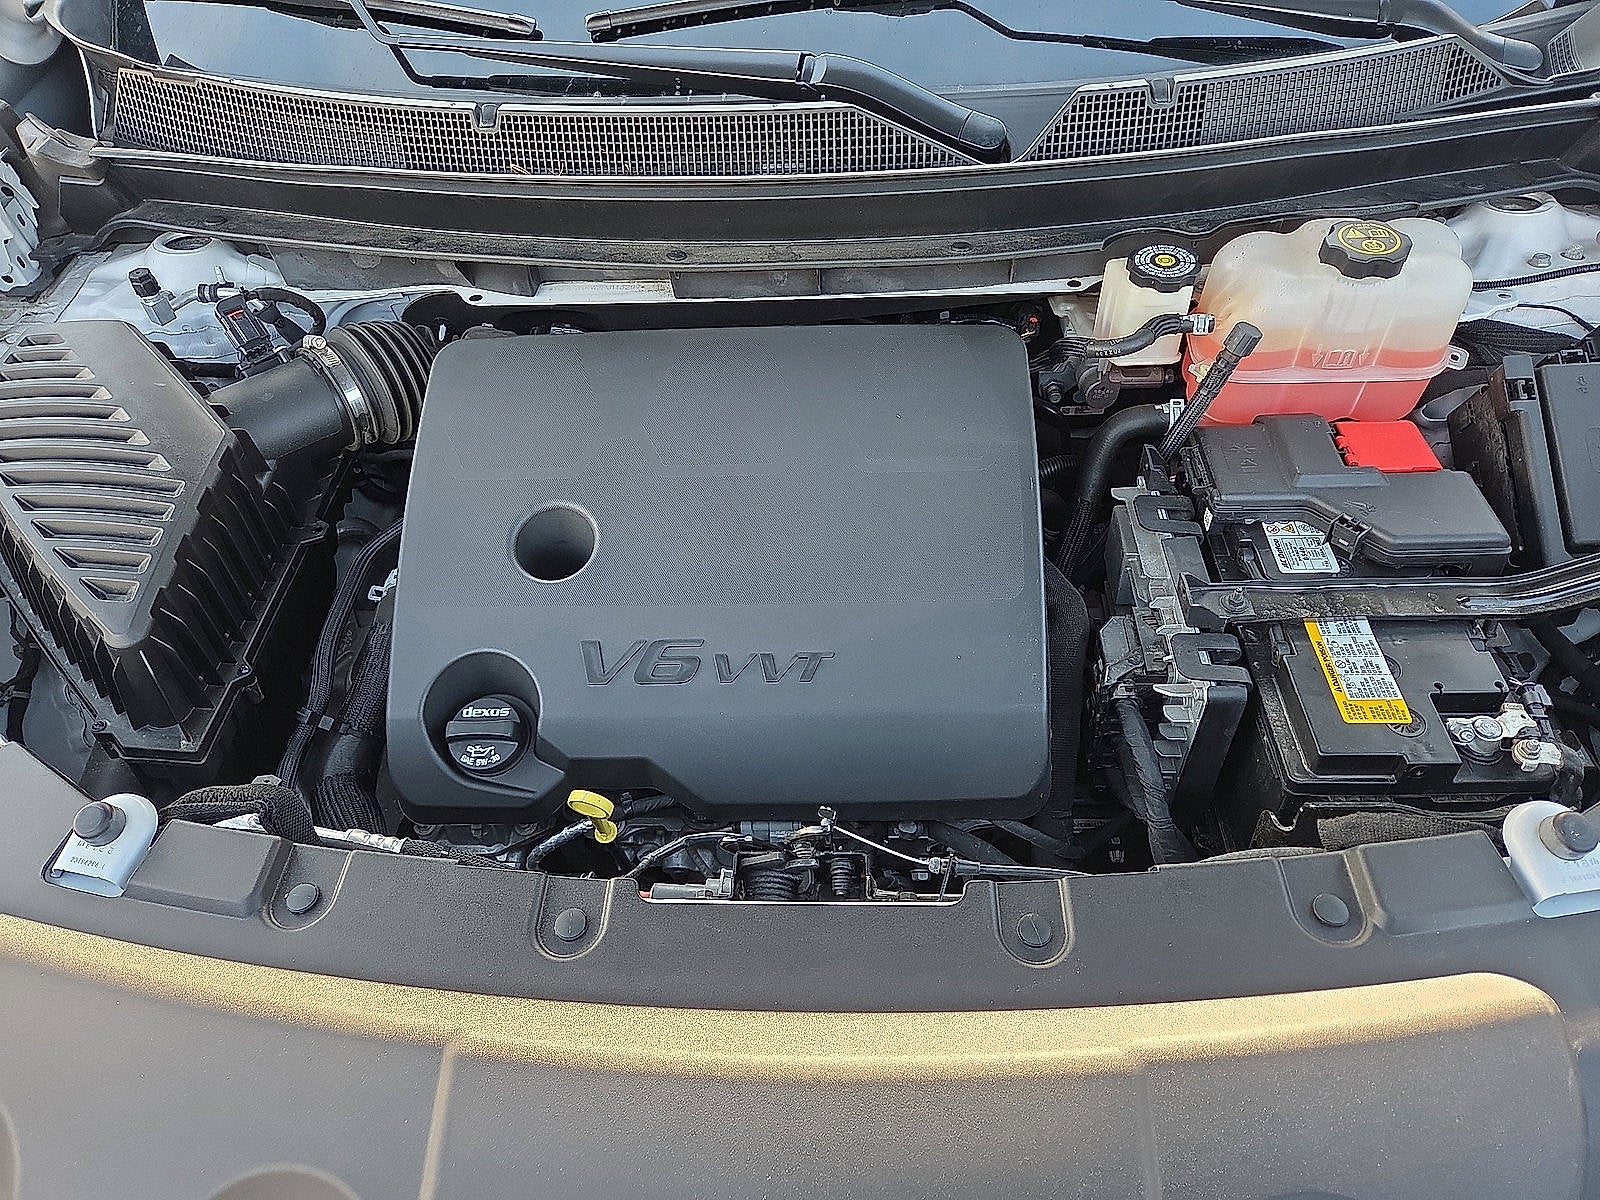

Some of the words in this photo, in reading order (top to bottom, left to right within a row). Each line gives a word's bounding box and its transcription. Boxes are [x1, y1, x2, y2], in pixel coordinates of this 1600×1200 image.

[580, 639, 705, 686] V6
[713, 651, 836, 684] VVT
[462, 706, 511, 718] dexos
[460, 754, 475, 766] SAE
[475, 753, 501, 767] 5W-30
